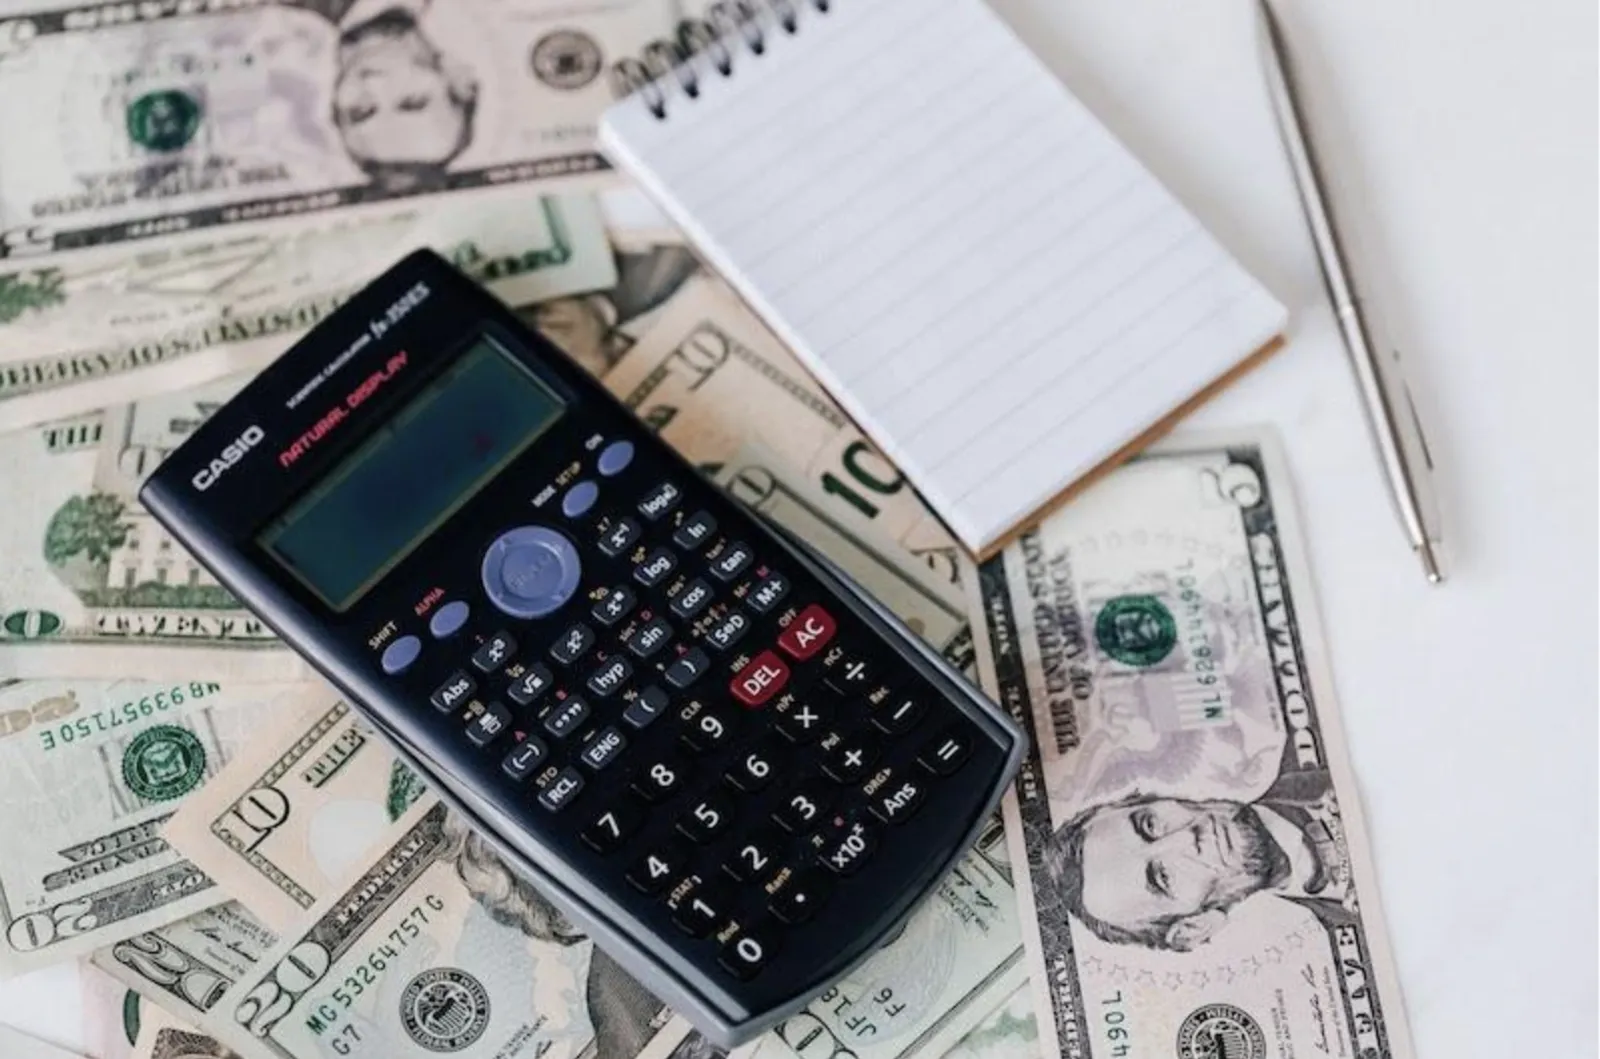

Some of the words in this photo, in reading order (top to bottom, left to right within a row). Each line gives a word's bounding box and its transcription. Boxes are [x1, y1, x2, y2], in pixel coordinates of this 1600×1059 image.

[279, 407, 349, 467] NATURAL
[346, 351, 408, 408] DISPLAY
[192, 425, 265, 491] CASIO
[821, 441, 905, 519] 10
[687, 522, 706, 538] ln
[643, 556, 672, 579] log
[721, 550, 747, 572] tan
[1018, 528, 1050, 600] STAT
[682, 586, 705, 609] cos
[756, 580, 783, 605] M+
[1048, 551, 1088, 661] AMERICA
[778, 608, 797, 627] OFF
[368, 620, 398, 649] SHIFT
[640, 626, 663, 648] sin
[796, 617, 825, 649] AC
[1032, 603, 1067, 695] UNITED
[1250, 530, 1319, 769] DOLLARS
[595, 663, 625, 688] hyp
[743, 665, 781, 696] DEL
[1069, 667, 1093, 701] OF
[442, 678, 470, 705] Abs
[681, 700, 703, 721] CLR
[700, 716, 724, 739] 9
[1049, 698, 1081, 755] THE
[589, 732, 620, 762] ENG
[535, 766, 558, 788] STO
[651, 763, 675, 787] 8
[746, 754, 770, 778] 6
[548, 778, 577, 804] RCL
[882, 782, 917, 817] Ans
[694, 803, 720, 829] 5
[791, 795, 816, 820] 3
[597, 812, 620, 838] 7
[648, 855, 670, 879] 4
[740, 845, 768, 871] 2
[332, 834, 430, 925] FEDERAL
[692, 898, 716, 919] 1
[6, 895, 99, 952] 20
[736, 937, 763, 963] 0
[236, 939, 333, 1039] 20
[1335, 924, 1379, 1051] FIVE
[872, 985, 907, 1019] F6
[1054, 953, 1081, 1059] EDERAL
[331, 1022, 365, 1057] G7
